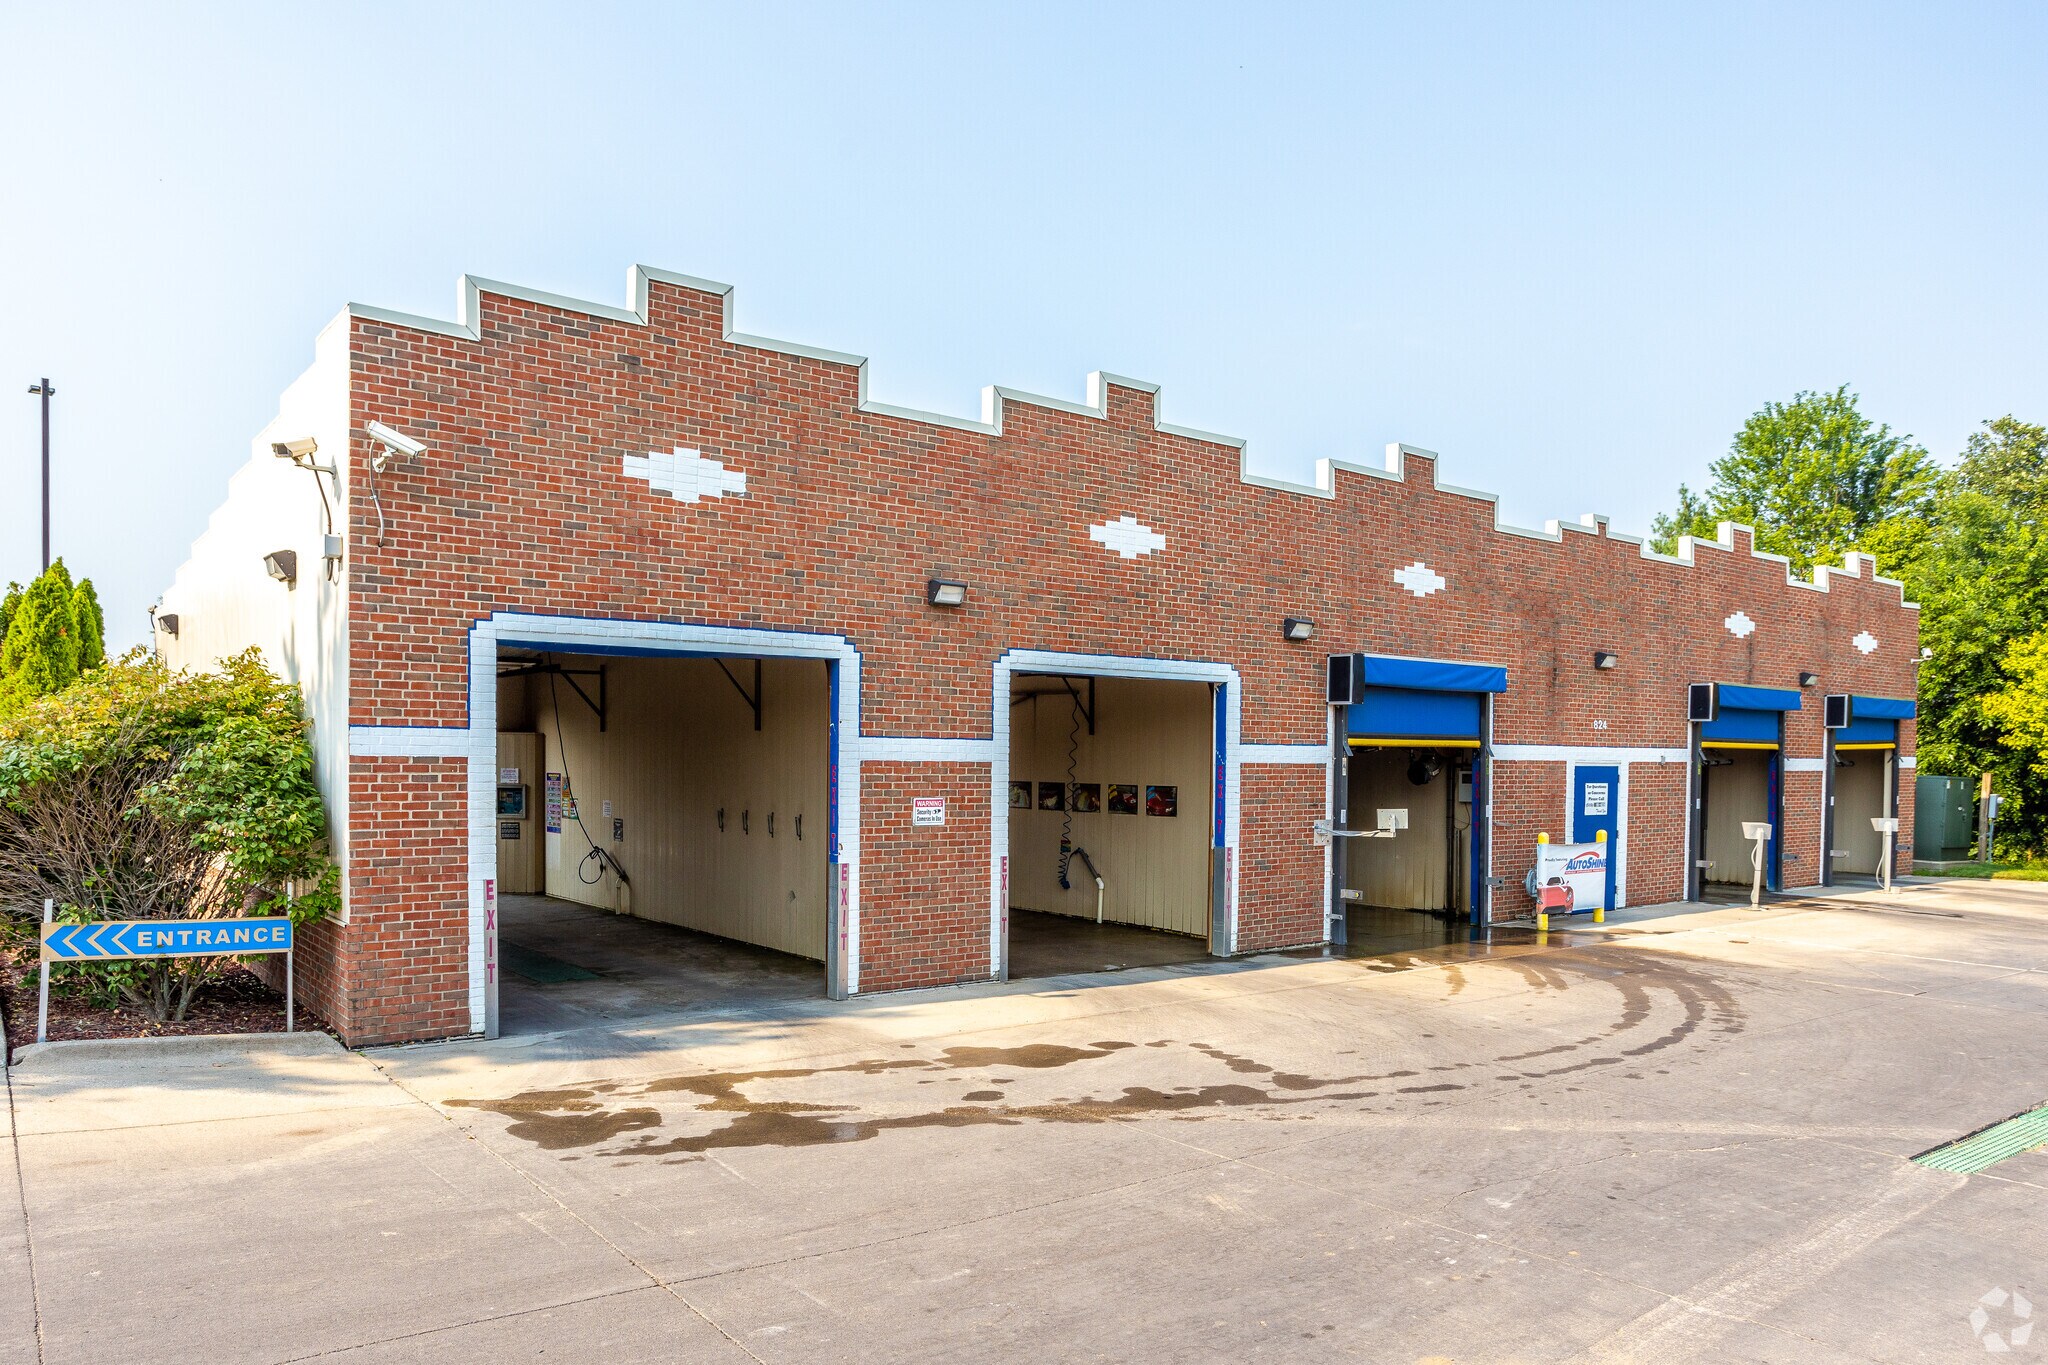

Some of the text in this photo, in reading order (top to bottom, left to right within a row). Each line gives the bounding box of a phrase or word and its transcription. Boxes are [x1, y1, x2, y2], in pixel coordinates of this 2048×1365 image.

[1593, 719, 1607, 730] 824
[916, 808, 932, 816] Security
[137, 926, 286, 947] ENTRANCE
[486, 879, 496, 984] EXIT
